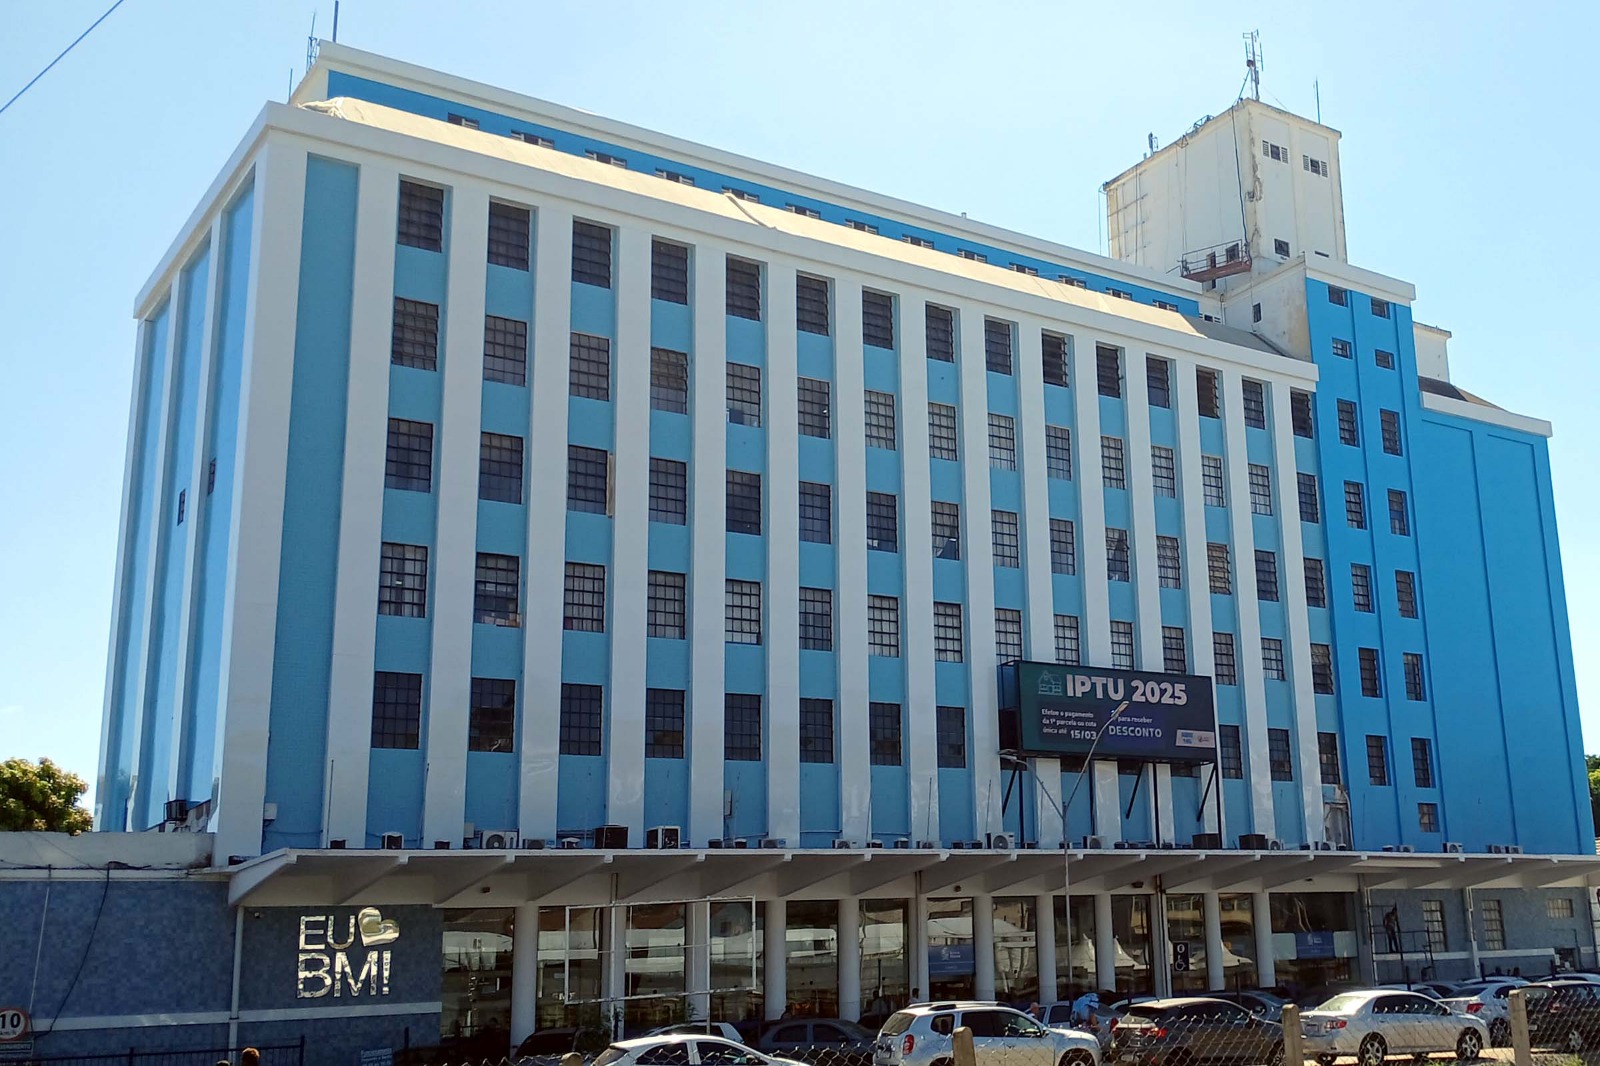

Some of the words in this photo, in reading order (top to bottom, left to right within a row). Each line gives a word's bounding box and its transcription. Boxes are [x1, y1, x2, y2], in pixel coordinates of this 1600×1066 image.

[1066, 674, 1125, 701] IPTU
[1131, 680, 1188, 706] 2025
[1065, 711, 1094, 719] pagamento
[1070, 729, 1097, 740] 15/03
[1108, 725, 1162, 738] DESCONTO
[299, 915, 356, 950] EU
[297, 950, 391, 998] BM!
[0, 1013, 21, 1029] 10
